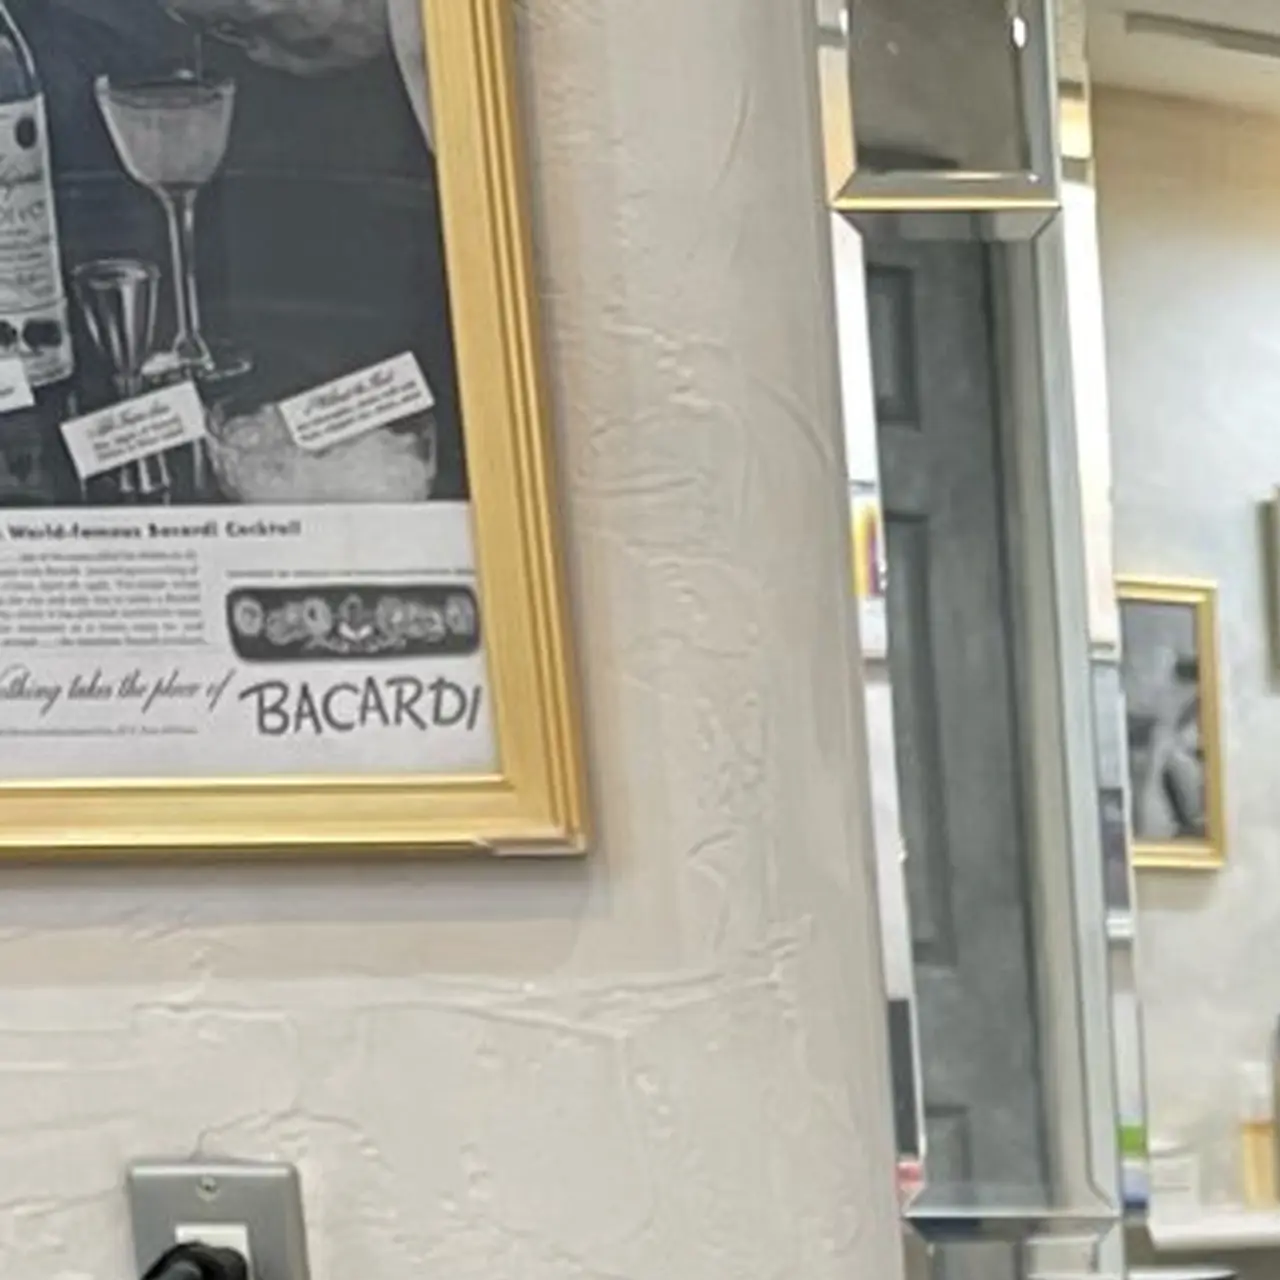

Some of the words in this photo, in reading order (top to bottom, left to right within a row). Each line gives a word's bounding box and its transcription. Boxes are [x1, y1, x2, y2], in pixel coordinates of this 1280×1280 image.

[8, 522, 141, 539] World-famous
[148, 521, 218, 537] Bacardi
[225, 519, 302, 537] Cocktail
[0, 663, 62, 717] thing
[67, 667, 113, 699] takes
[116, 668, 147, 699] the
[141, 669, 201, 714] place
[205, 667, 237, 712] of
[237, 675, 483, 736] BACARDI
